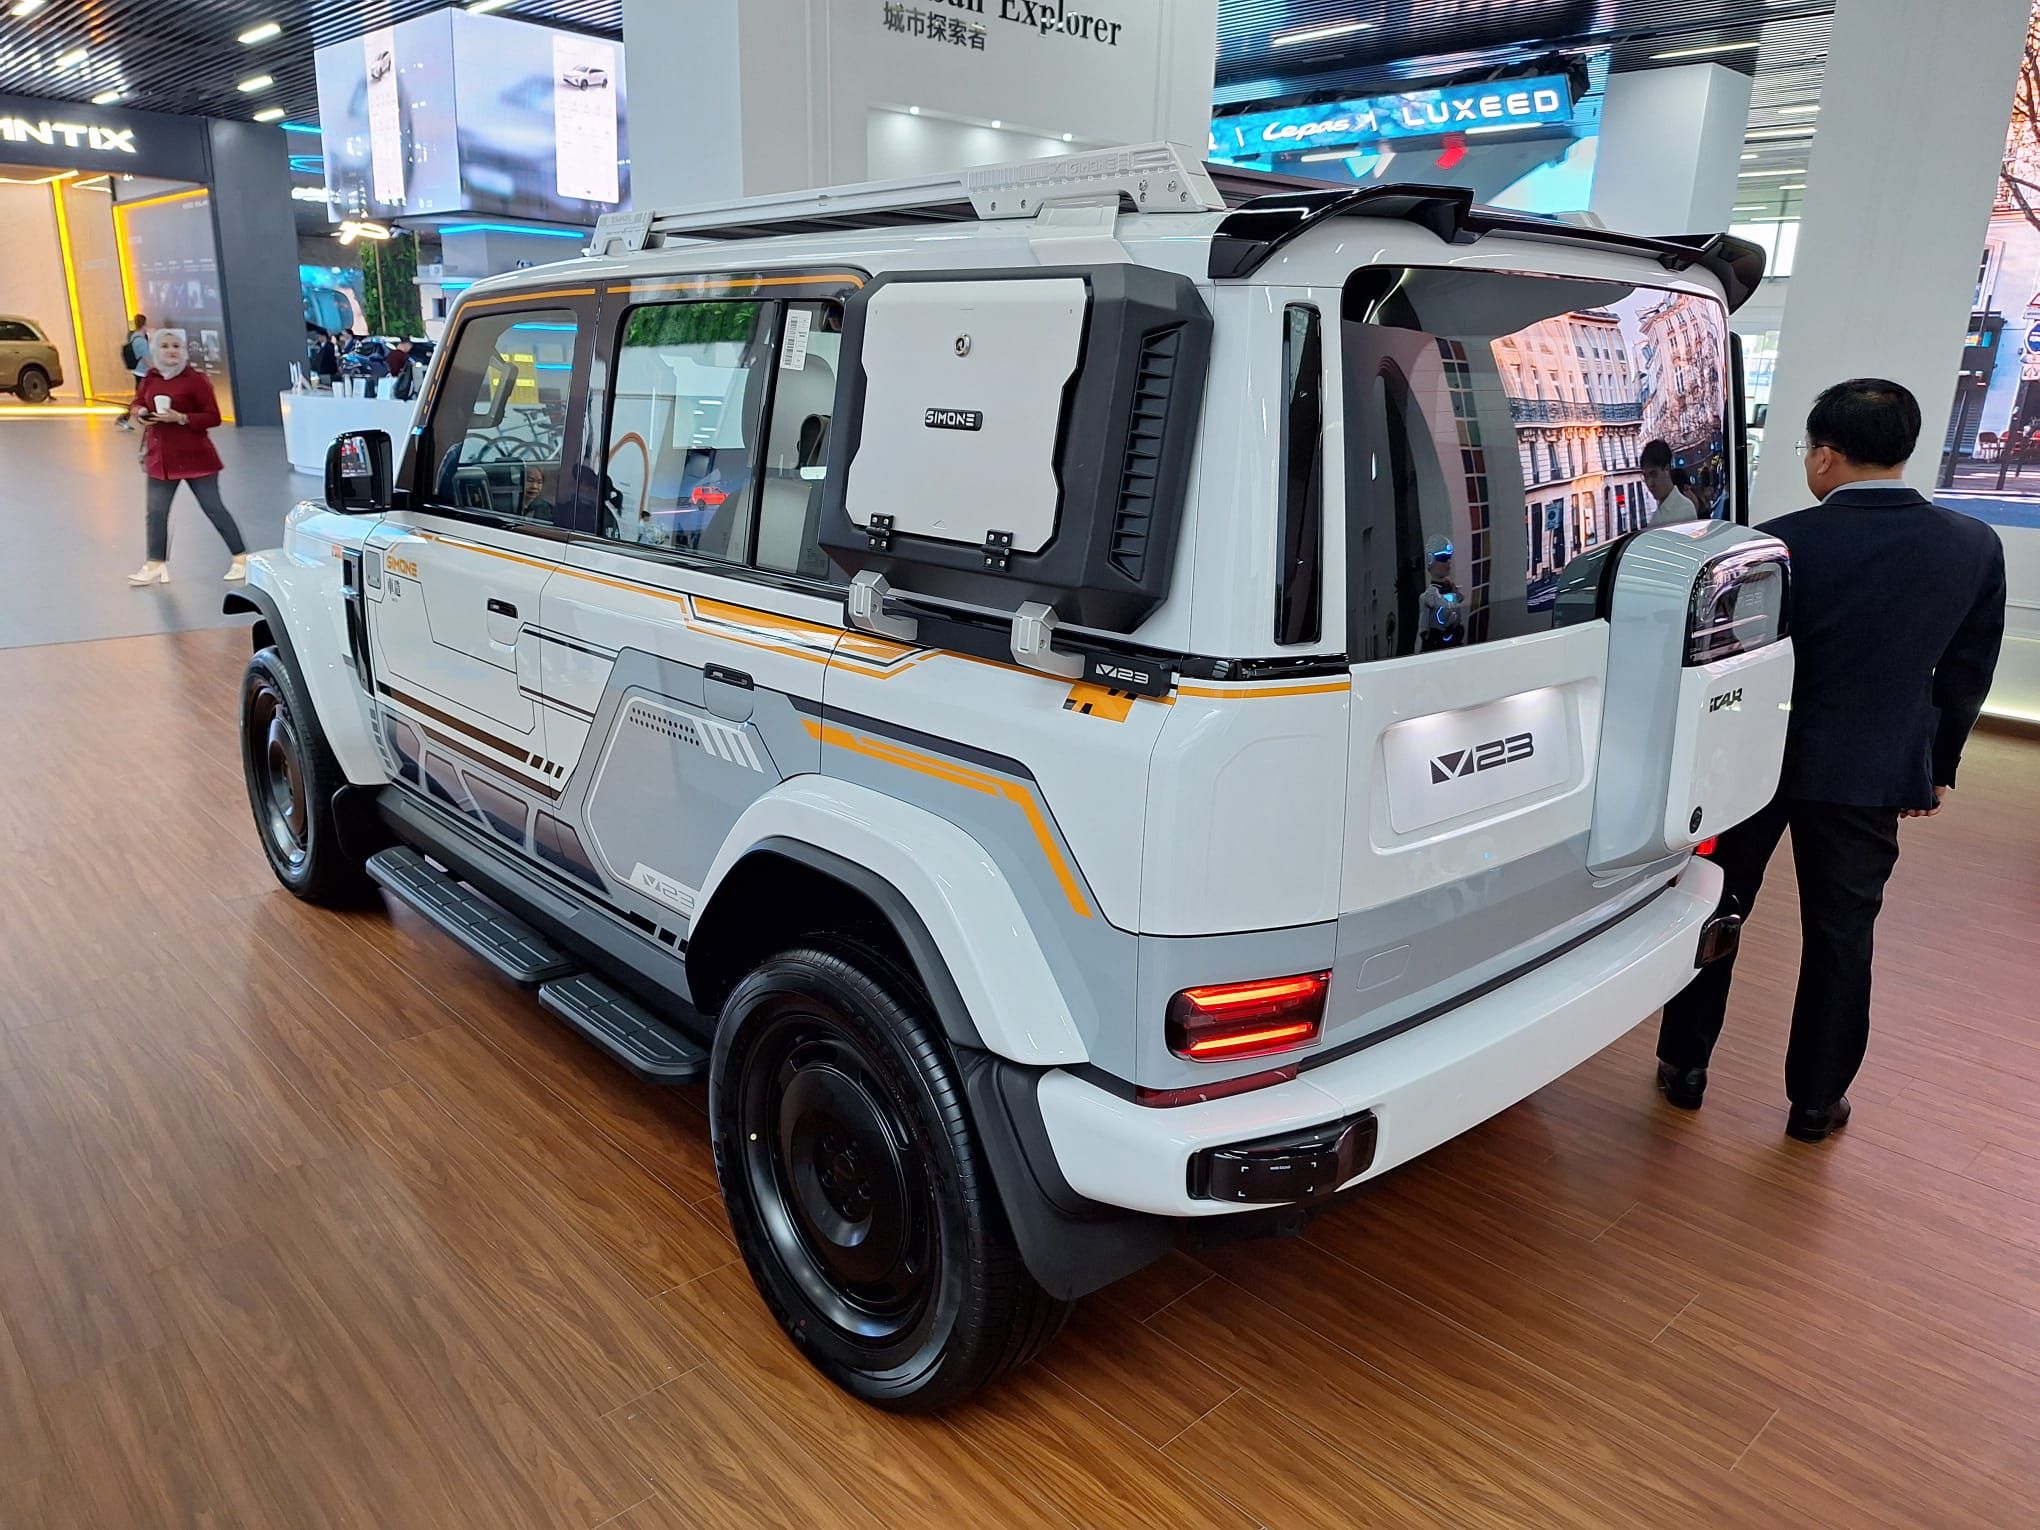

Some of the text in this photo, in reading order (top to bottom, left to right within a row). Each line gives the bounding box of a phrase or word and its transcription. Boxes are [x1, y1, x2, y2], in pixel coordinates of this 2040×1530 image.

[883, 3, 987, 51] 城市探索者
[998, 0, 1121, 46] Explorer
[1402, 89, 1560, 126] LUXEED
[925, 410, 976, 427] SIMONE
[386, 555, 418, 577] SIMONE
[1095, 663, 1150, 685] V23
[1430, 731, 1534, 785] V23
[642, 872, 695, 910] V23
